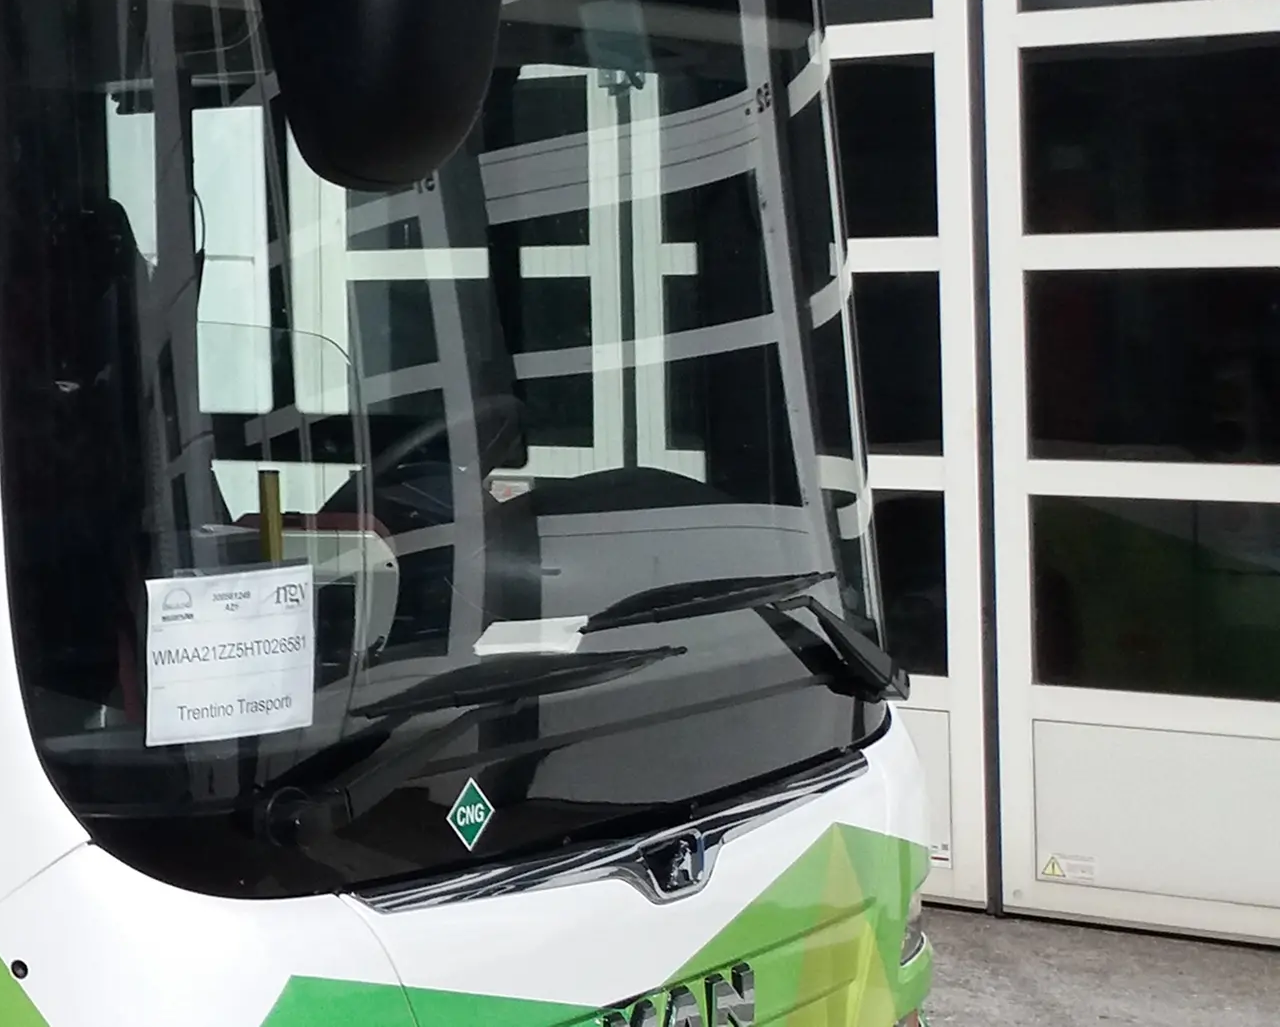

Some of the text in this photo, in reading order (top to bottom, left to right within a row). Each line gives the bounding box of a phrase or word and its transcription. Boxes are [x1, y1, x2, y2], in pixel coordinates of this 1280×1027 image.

[177, 695, 292, 721] Trentino Trasporti
[456, 802, 486, 827] CNG
